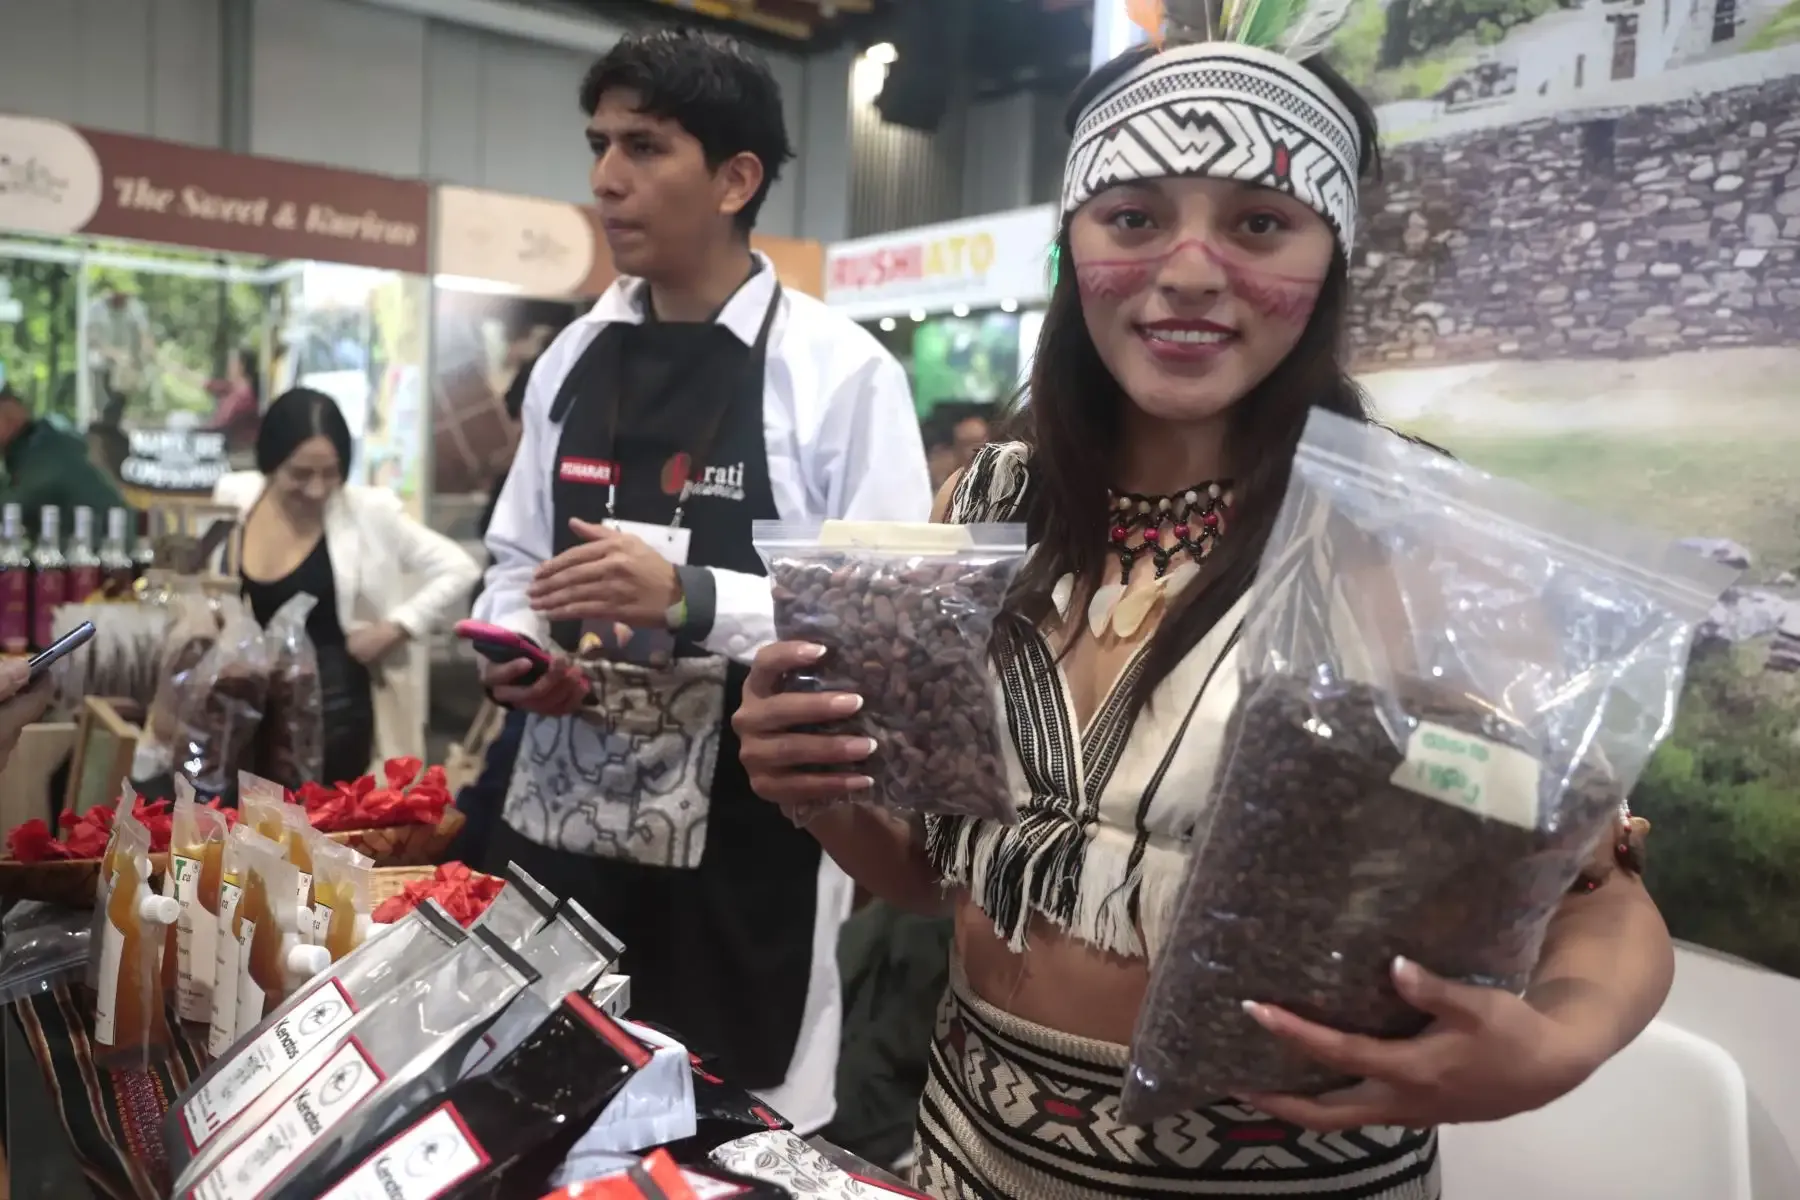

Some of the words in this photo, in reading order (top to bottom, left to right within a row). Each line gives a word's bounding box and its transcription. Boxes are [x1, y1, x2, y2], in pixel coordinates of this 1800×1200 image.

[113, 175, 175, 213] The
[272, 201, 297, 230] &
[274, 1017, 300, 1060] Kenatos
